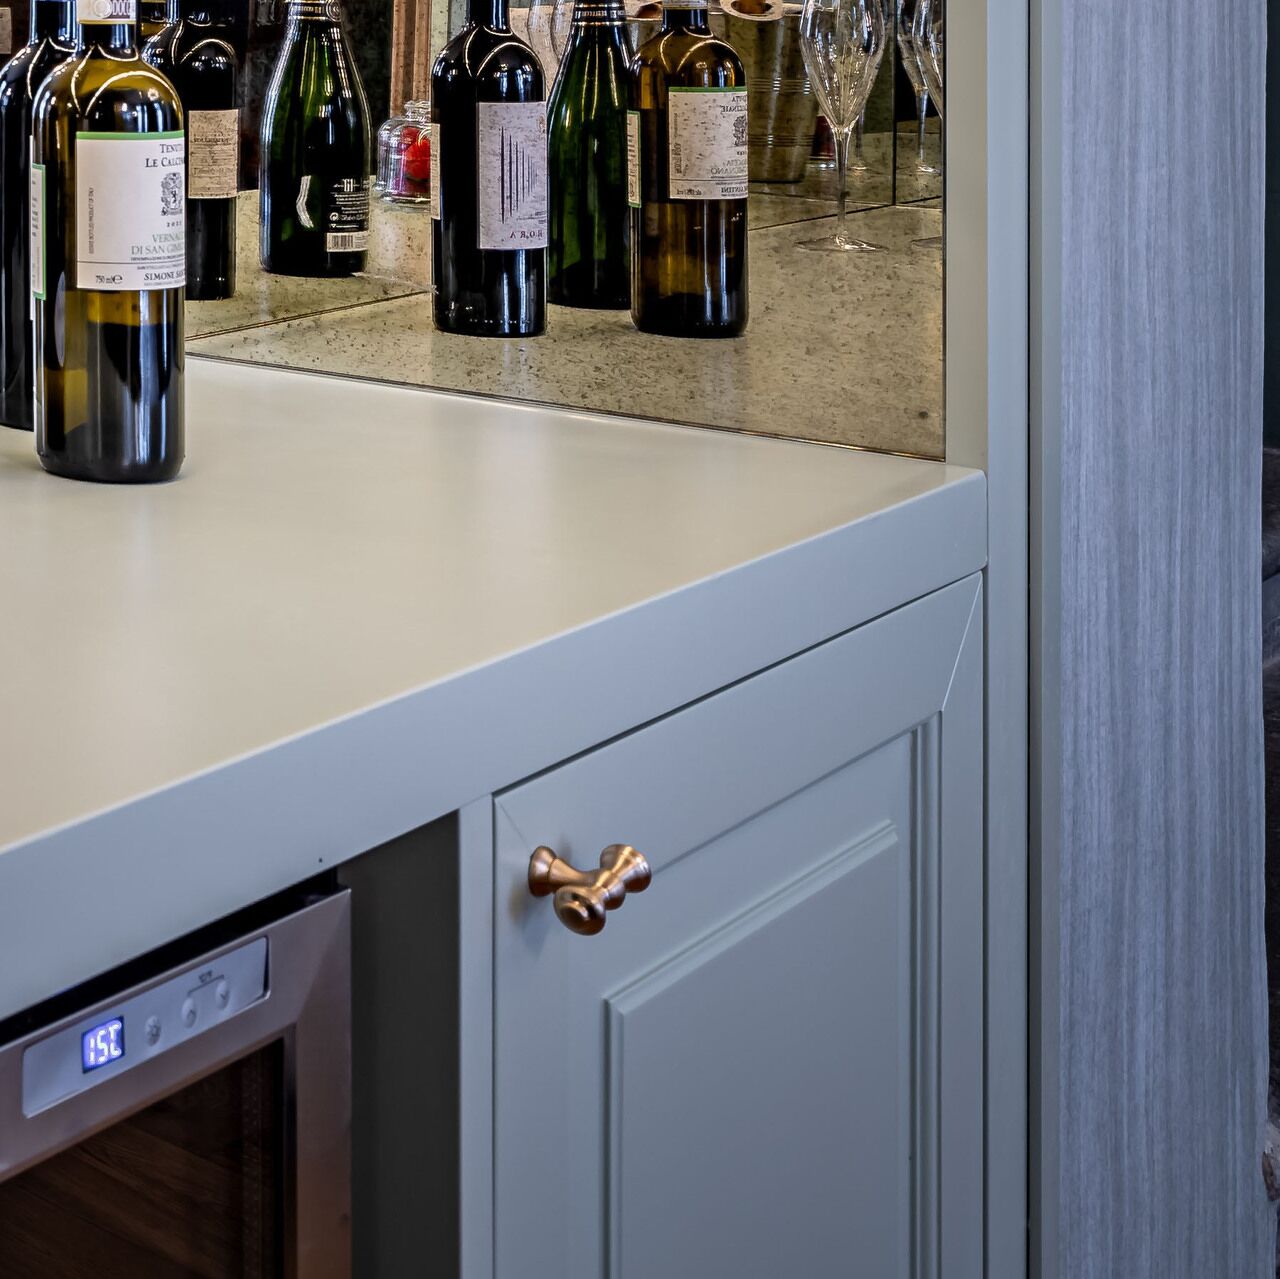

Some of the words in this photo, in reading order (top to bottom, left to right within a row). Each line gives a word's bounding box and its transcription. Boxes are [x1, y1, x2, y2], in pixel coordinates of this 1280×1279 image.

[145, 158, 158, 168] LE
[131, 245, 143, 255] DI
[145, 244, 165, 255] SAN
[144, 271, 175, 281] SIMONE
